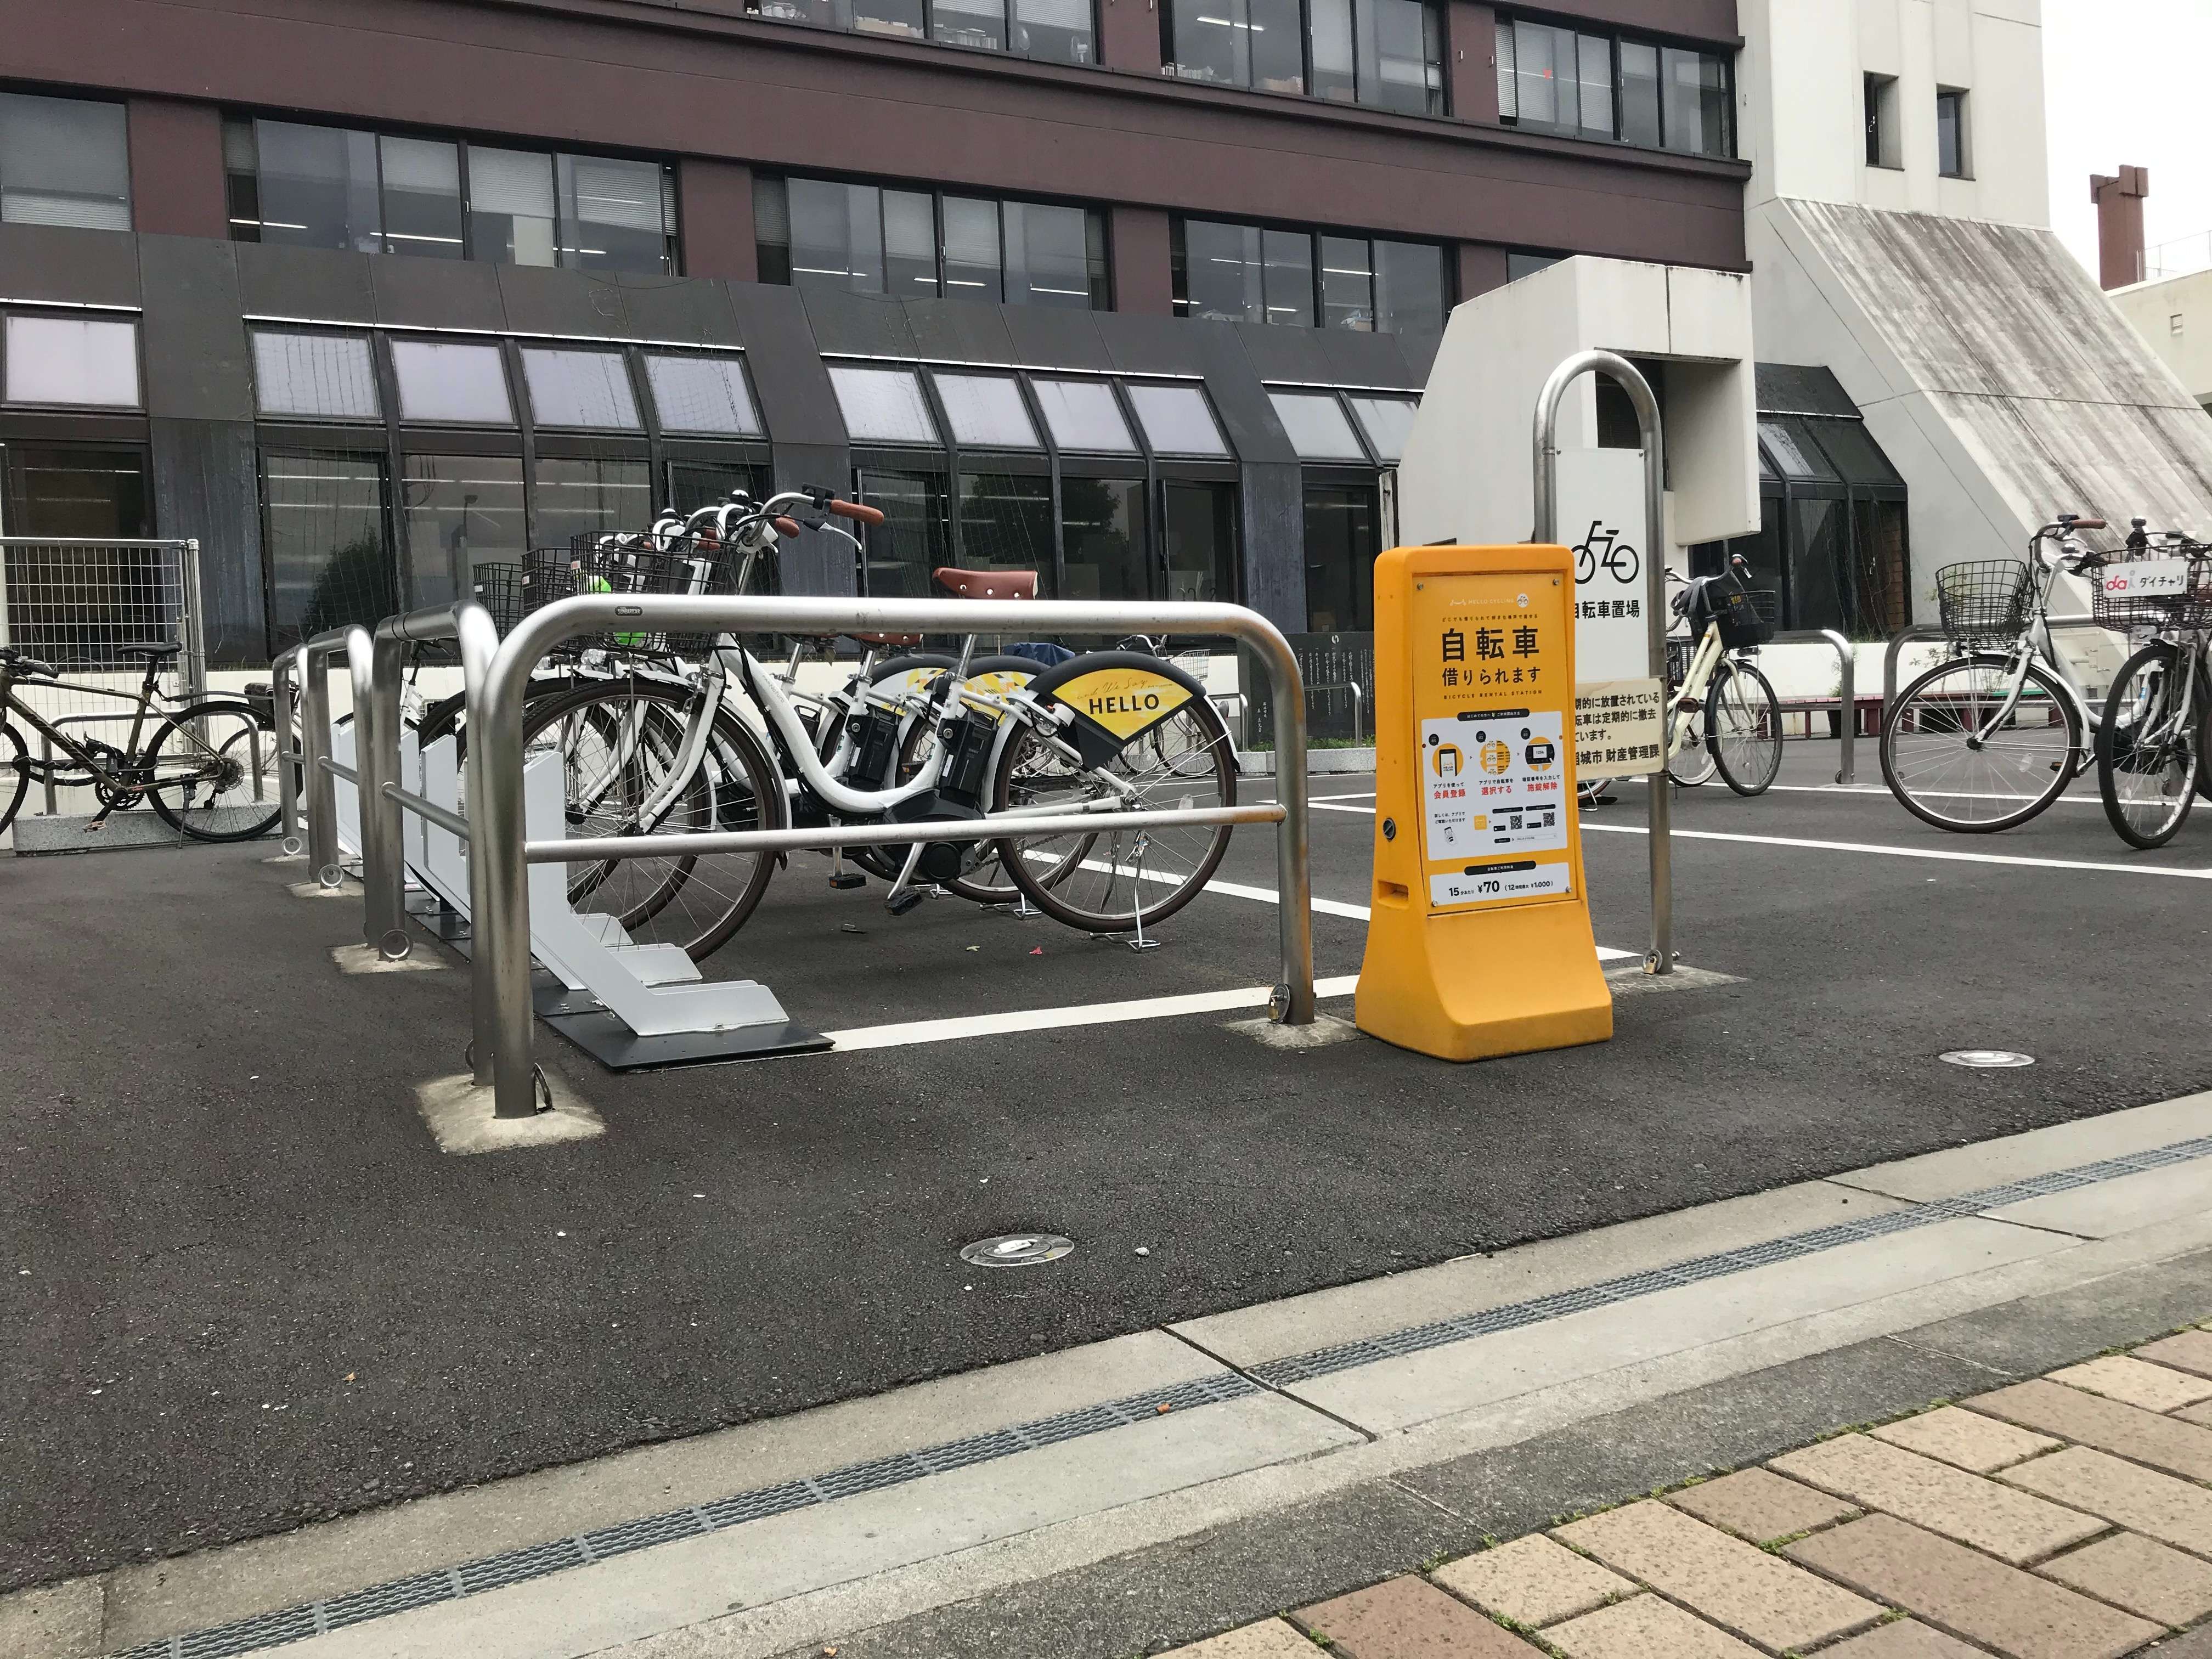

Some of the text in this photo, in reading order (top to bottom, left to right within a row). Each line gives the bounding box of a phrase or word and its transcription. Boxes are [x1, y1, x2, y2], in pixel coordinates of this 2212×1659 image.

[2139, 575, 2185, 588] ダイチャリ
[1442, 625, 1539, 662] 自転車
[1442, 667, 1541, 687] 借りられます
[1089, 693, 1159, 715] HELLO
[1606, 744, 1660, 763] 財産管理課
[1481, 786, 1513, 795] 選択する
[1527, 782, 1558, 792] 施錠解除
[1434, 789, 1466, 799] 会員登録
[1477, 880, 1500, 893] ¥70
